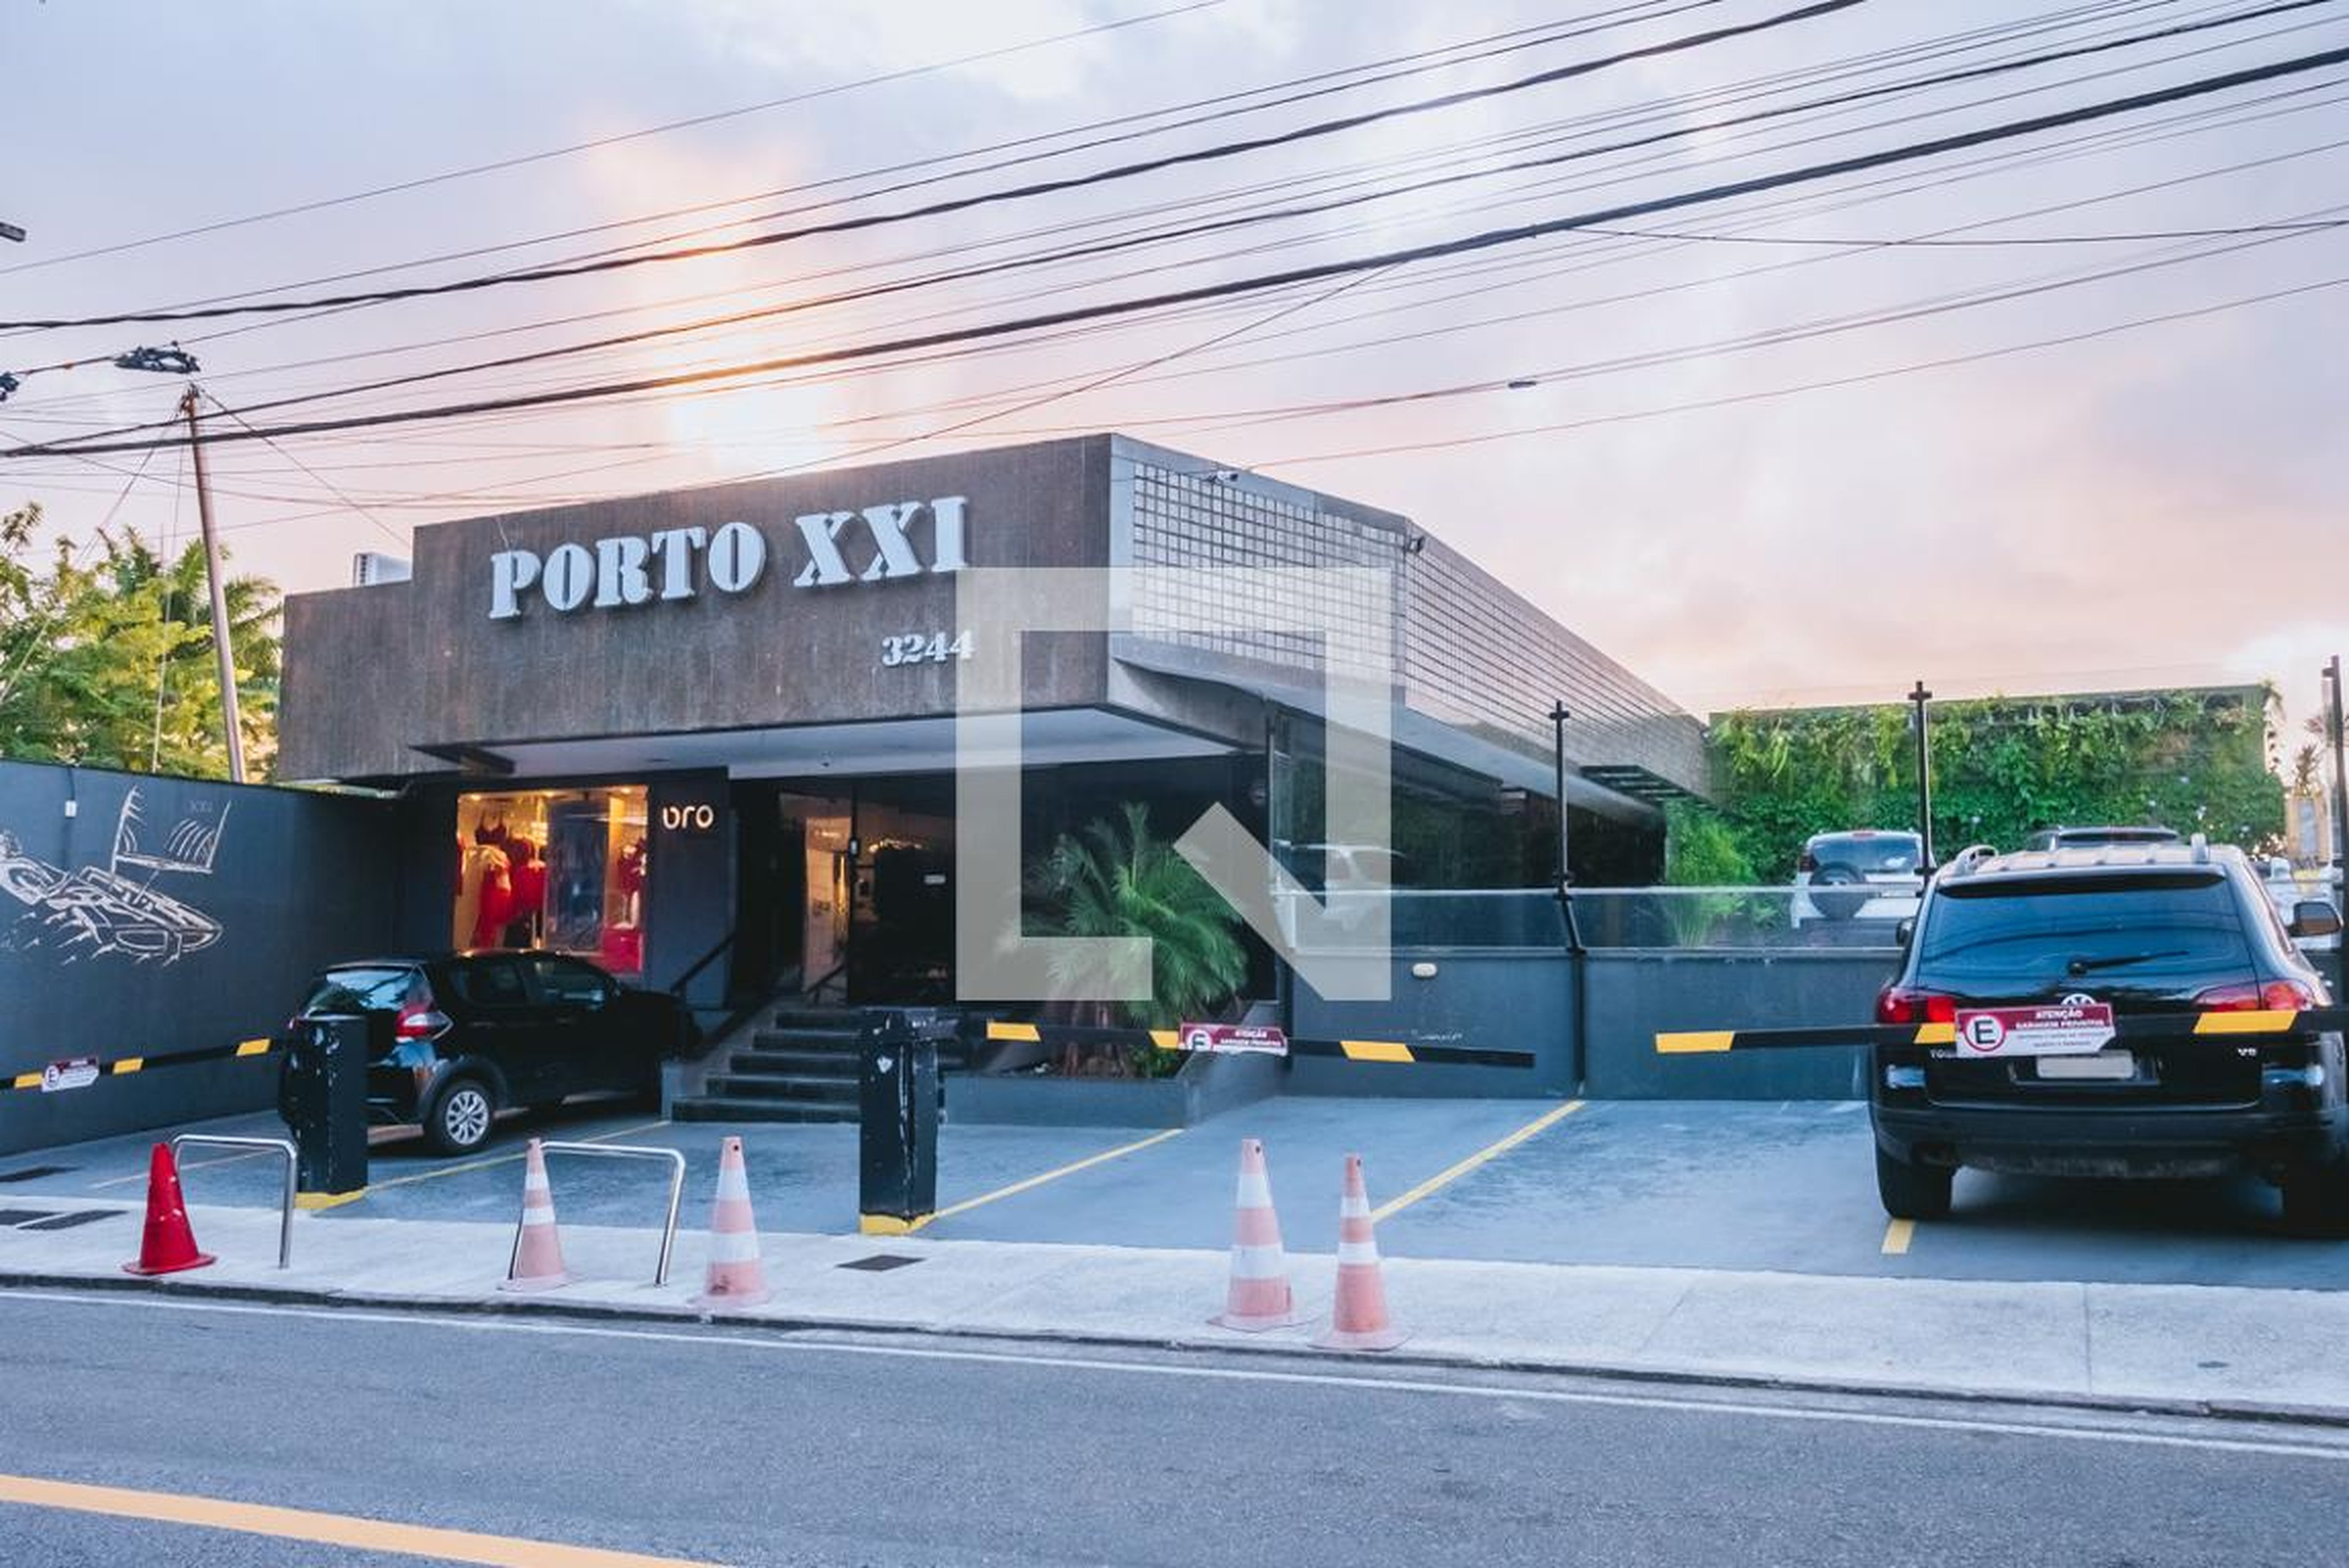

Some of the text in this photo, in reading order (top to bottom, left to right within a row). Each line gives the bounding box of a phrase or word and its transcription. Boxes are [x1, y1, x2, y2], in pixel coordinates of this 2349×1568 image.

[489, 495, 970, 619] PORTO XXI
[882, 630, 975, 666] 3244
[1974, 1020, 1996, 1045] E
